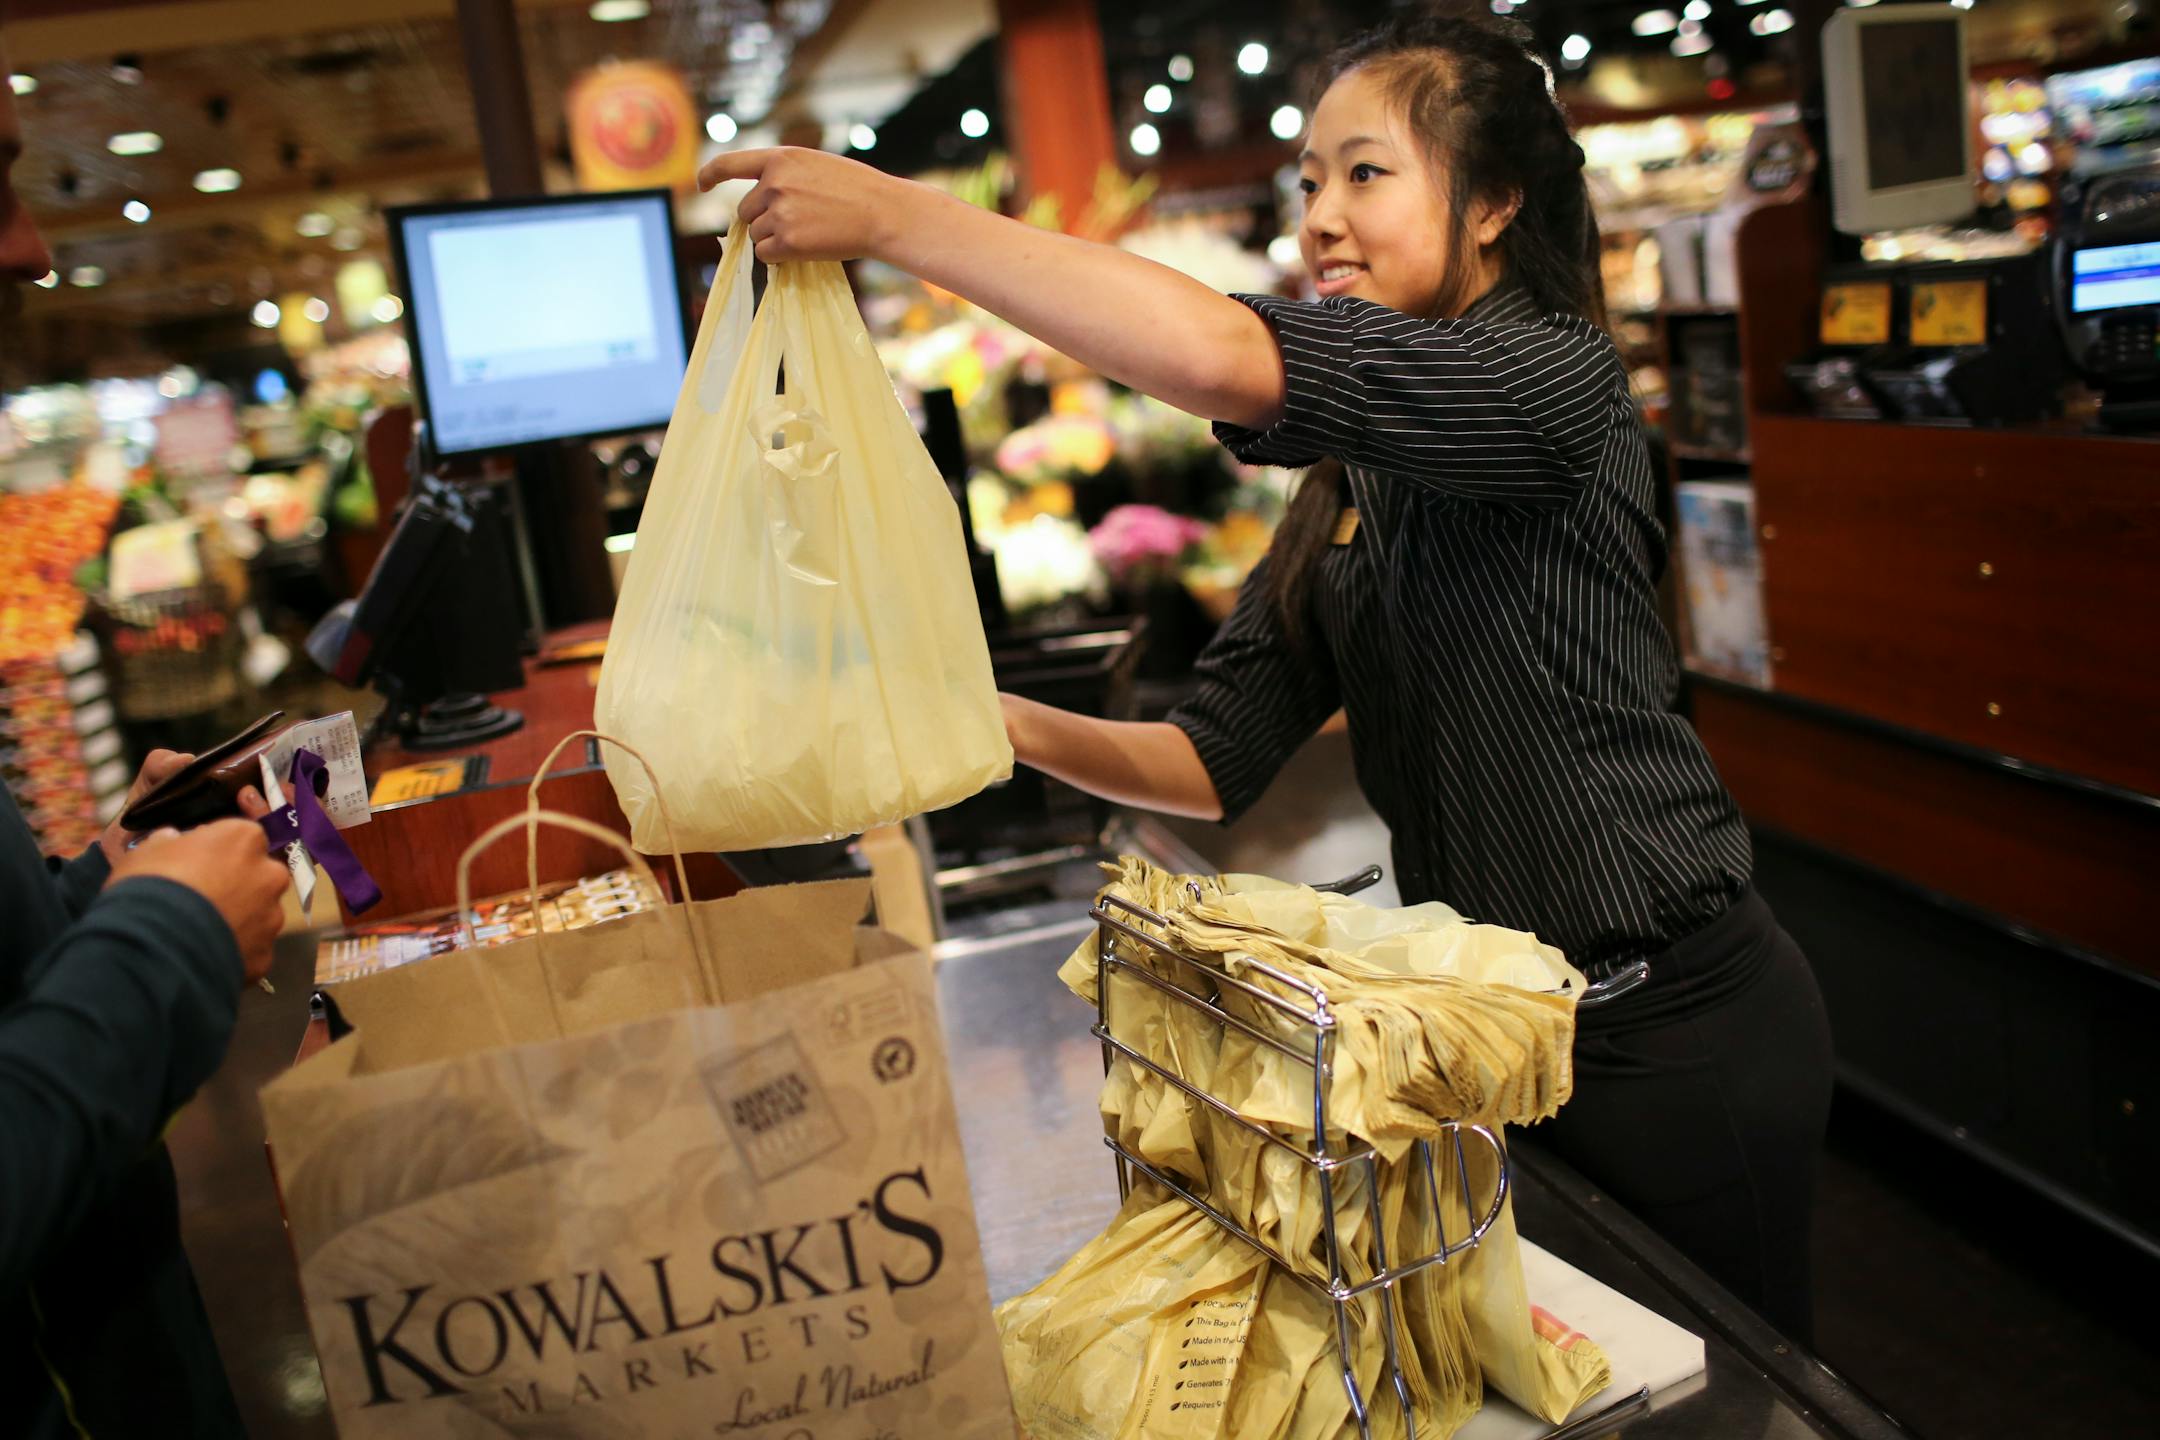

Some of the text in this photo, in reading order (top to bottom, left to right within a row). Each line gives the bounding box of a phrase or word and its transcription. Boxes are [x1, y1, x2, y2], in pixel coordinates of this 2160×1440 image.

[337, 1164, 945, 1408] KOWALSKI'S
[1197, 1317, 1211, 1325] This
[1213, 1319, 1229, 1328] Bag
[1191, 1336, 1212, 1345] Made
[1214, 1336, 1222, 1344] in
[504, 1304, 872, 1416] MARKETS
[1190, 1357, 1209, 1367] Made
[1211, 1355, 1227, 1365] with
[1186, 1379, 1223, 1389] Generates
[1182, 1401, 1216, 1410] Requires
